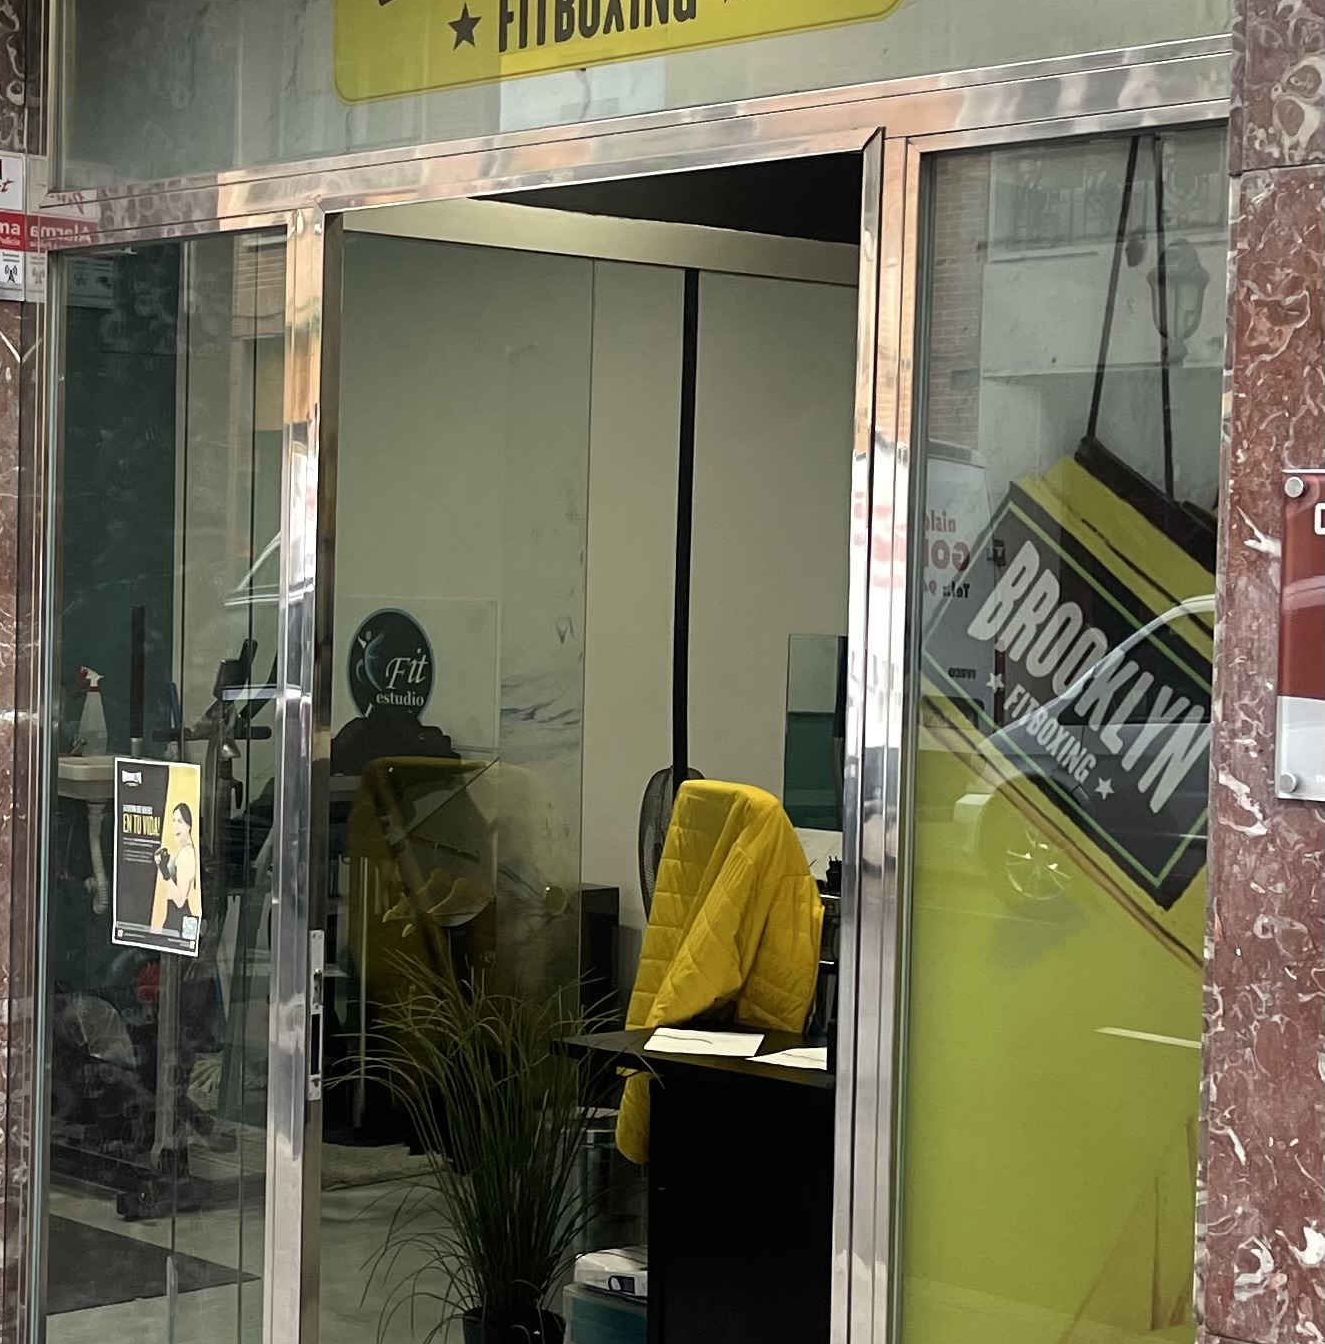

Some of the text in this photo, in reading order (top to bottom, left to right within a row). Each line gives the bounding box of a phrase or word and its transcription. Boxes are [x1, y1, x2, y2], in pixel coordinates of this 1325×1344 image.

[376, 691, 425, 707] estudio
[385, 647, 429, 690] Fit
[966, 540, 1210, 814] BROOKLYN
[1003, 683, 1096, 785] FITBOXING
